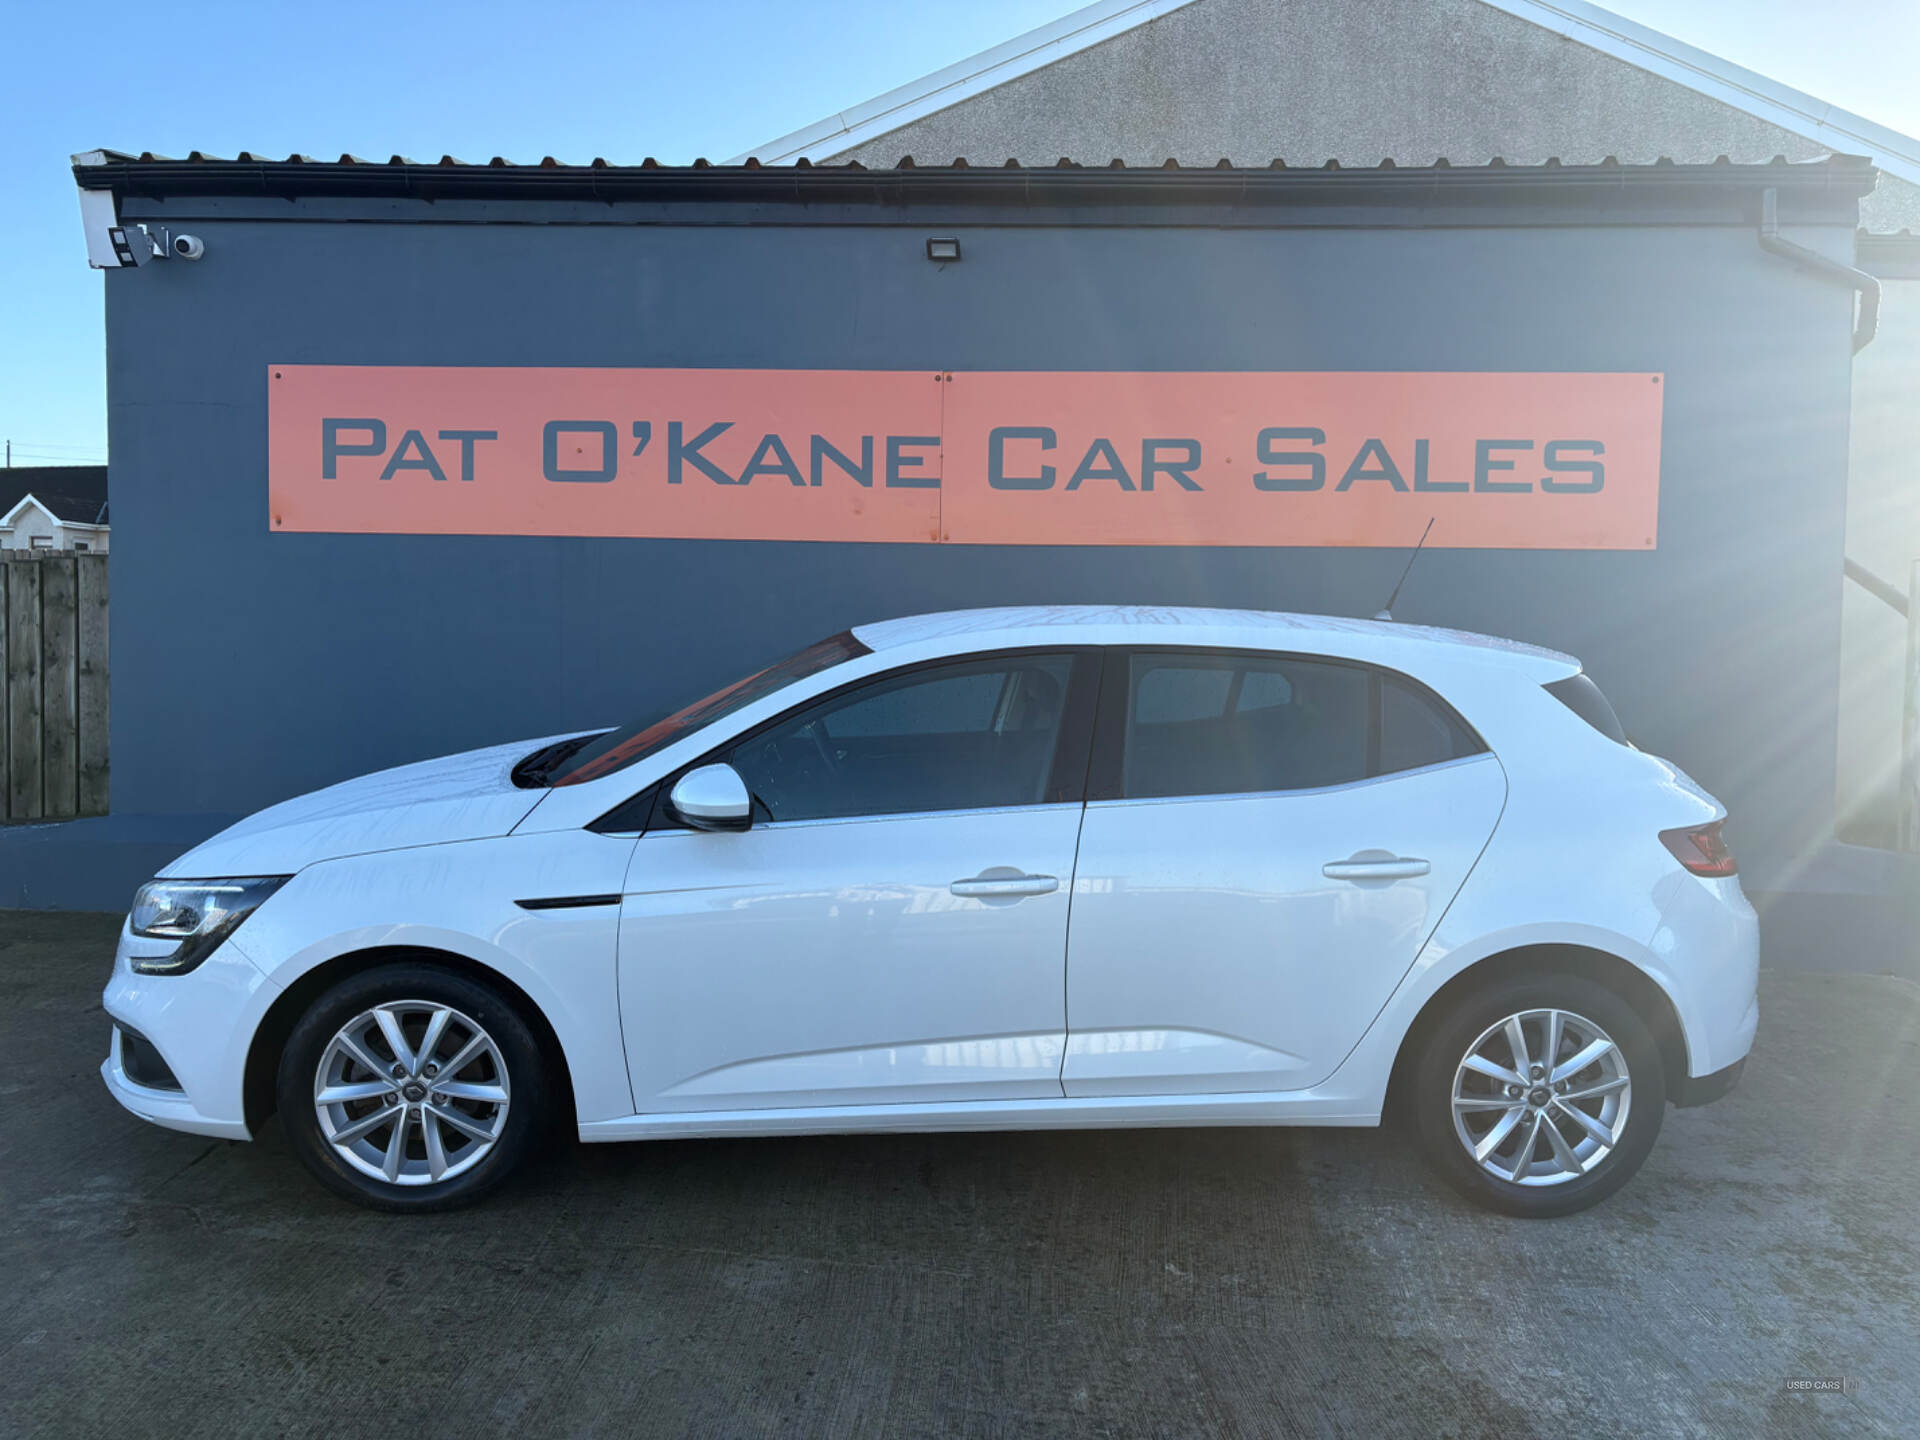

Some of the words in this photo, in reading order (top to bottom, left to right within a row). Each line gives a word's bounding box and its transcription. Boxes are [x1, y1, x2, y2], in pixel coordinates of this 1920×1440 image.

[322, 418, 498, 481] PAT
[988, 426, 1205, 491] CAR
[1252, 427, 1605, 494] SALES
